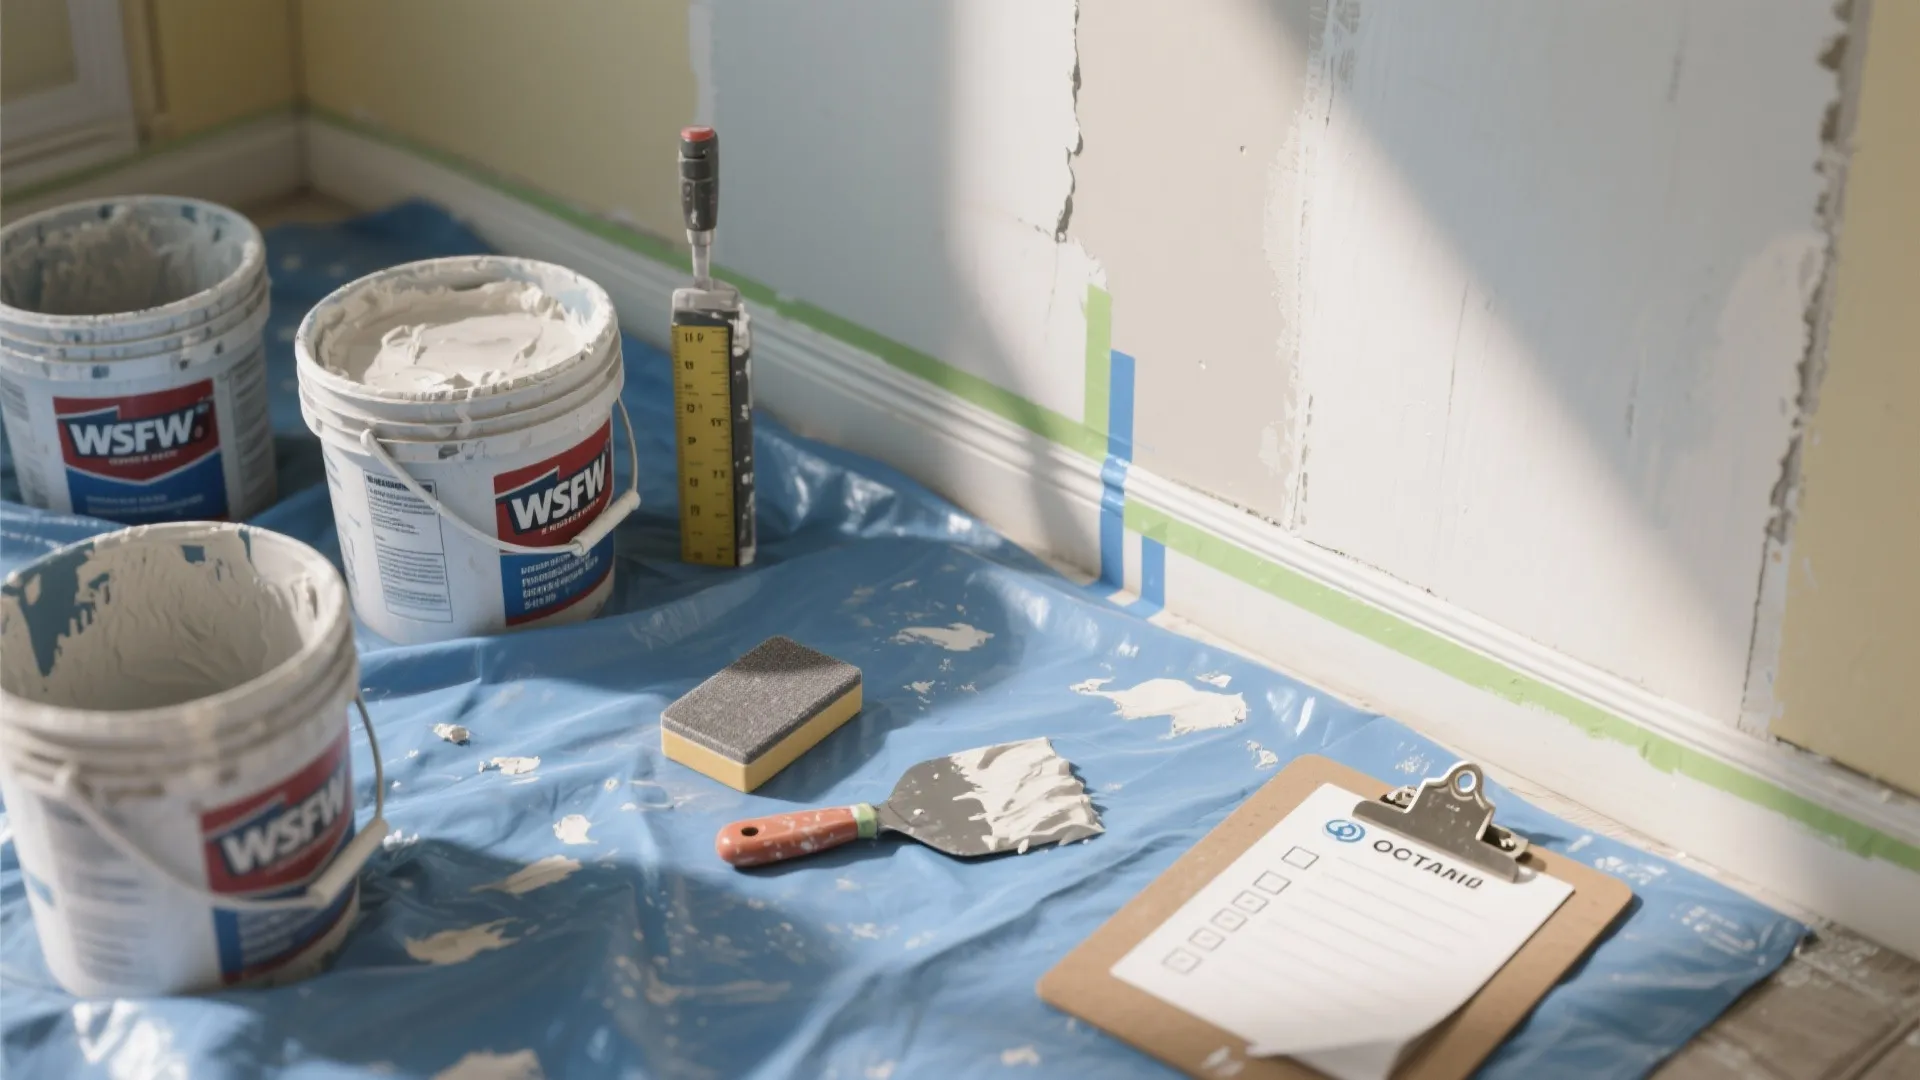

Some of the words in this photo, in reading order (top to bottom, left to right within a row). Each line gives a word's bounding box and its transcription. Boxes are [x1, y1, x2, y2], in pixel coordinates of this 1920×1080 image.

[69, 410, 194, 455] WSFW
[511, 452, 606, 530] WSFW
[223, 765, 345, 874] WSFW
